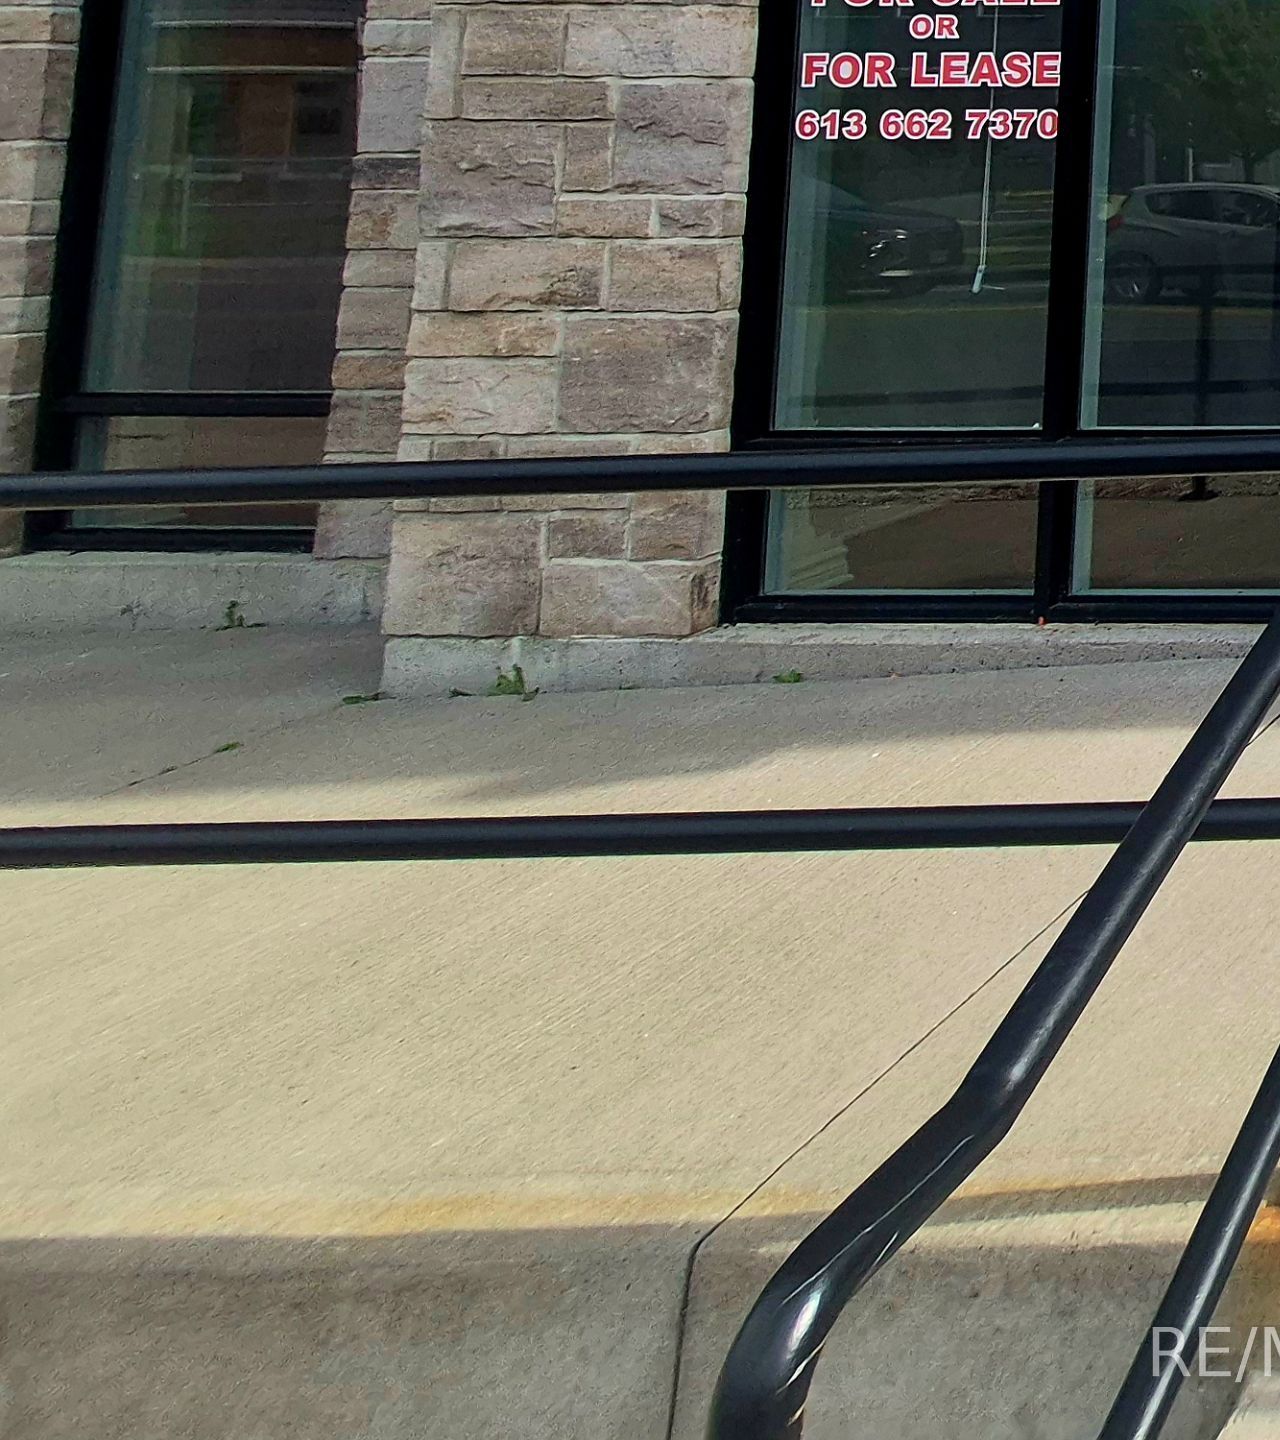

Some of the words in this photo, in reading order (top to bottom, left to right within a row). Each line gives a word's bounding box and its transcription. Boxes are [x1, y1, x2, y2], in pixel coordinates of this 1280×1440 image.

[909, 14, 960, 40] OR
[801, 52, 898, 88] FOR
[911, 51, 1062, 88] LEASE
[795, 109, 868, 140] 613
[879, 109, 952, 140] 662
[965, 109, 1059, 140] 7370
